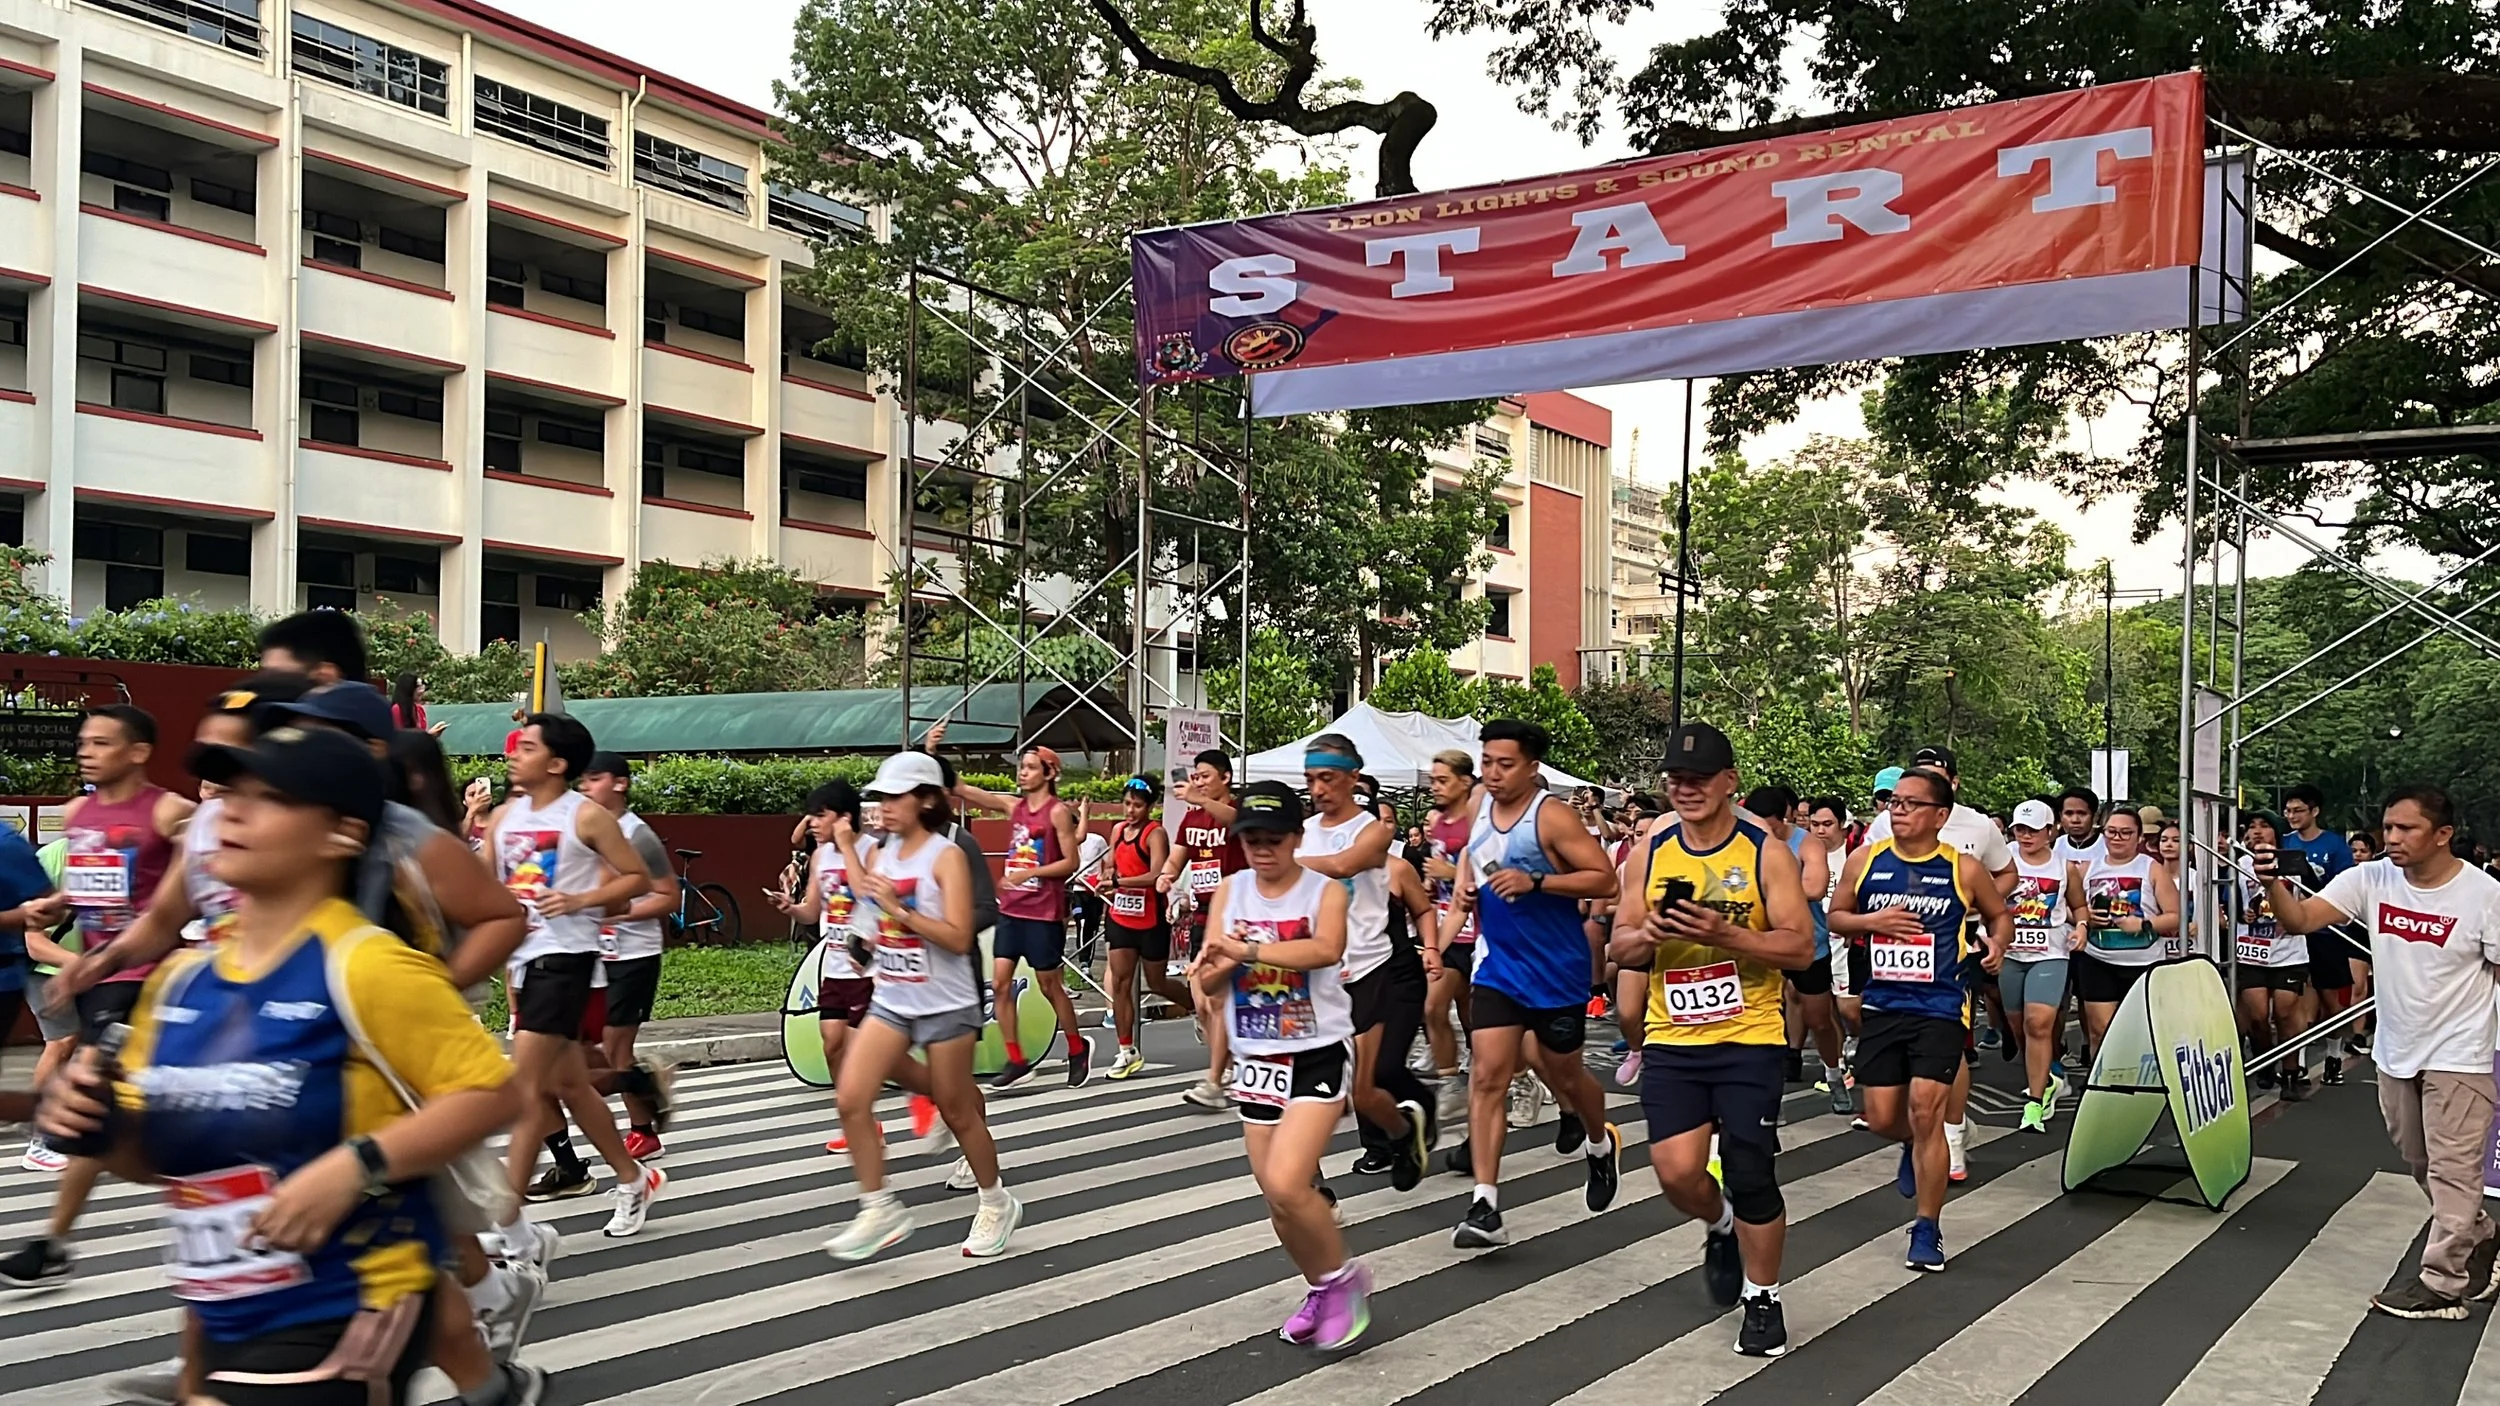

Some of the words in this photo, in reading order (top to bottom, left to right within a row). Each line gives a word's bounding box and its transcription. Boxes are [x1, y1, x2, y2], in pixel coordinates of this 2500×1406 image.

[1328, 205, 1423, 232] LEON
[1437, 183, 1579, 219] LIGHTS
[1595, 178, 1619, 193] &
[1637, 152, 1781, 188] SOUND
[1797, 121, 1986, 162] RENTAL
[1208, 126, 2153, 318] START
[1192, 871, 1219, 885] 0109
[1116, 896, 1143, 910] 0155
[2015, 931, 2047, 945] 159
[1874, 949, 1931, 969] 0168
[2236, 944, 2269, 959] 0156
[1669, 981, 1738, 1011] 0132
[2174, 1038, 2235, 1136] Fitbar
